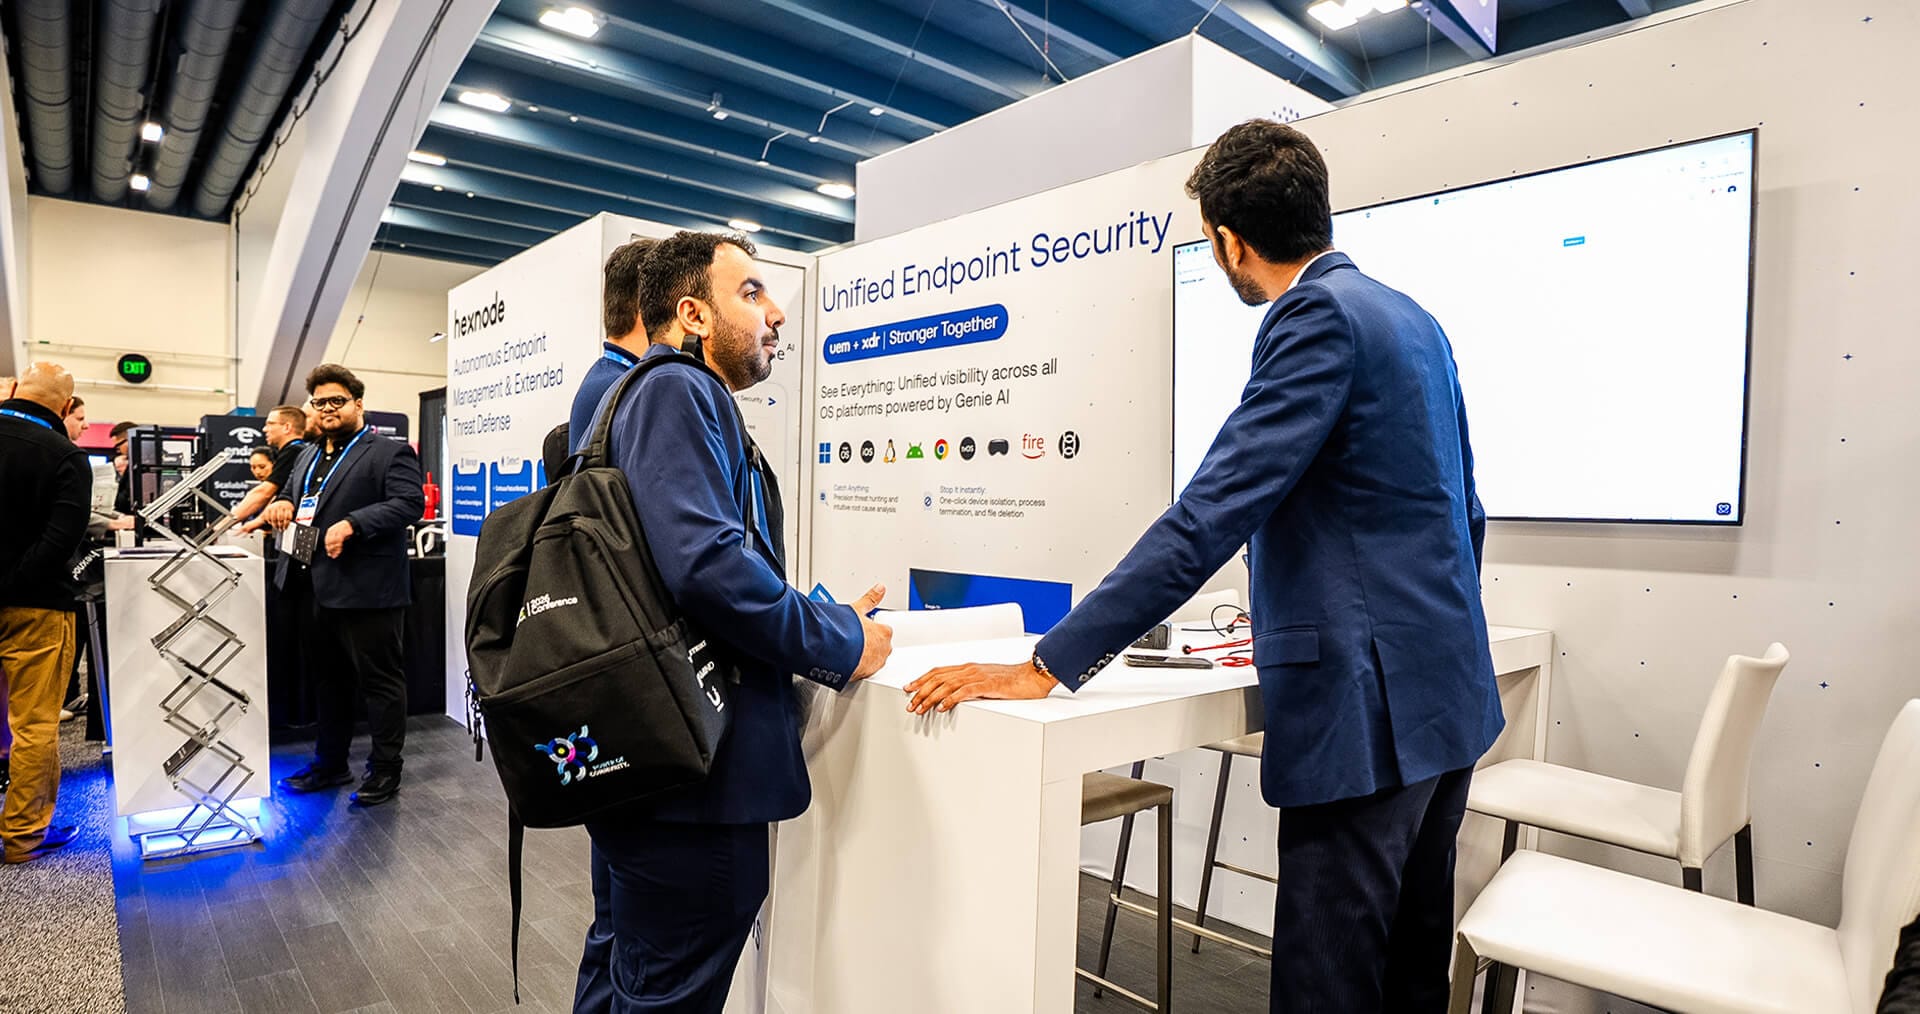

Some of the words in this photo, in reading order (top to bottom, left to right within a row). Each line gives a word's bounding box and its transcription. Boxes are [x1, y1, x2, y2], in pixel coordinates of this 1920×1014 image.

[822, 270, 895, 313] Unified
[903, 242, 1021, 294] Endpoint
[1031, 211, 1173, 268] Security
[454, 290, 505, 339] hexnode
[829, 341, 850, 354] uem
[862, 331, 880, 350] xdr
[889, 326, 938, 344] Stronger
[941, 314, 999, 338] Together
[454, 348, 501, 376] Autonomous
[504, 331, 547, 364] Endpoint
[123, 361, 146, 374] EXIT
[821, 385, 838, 399] See
[841, 379, 895, 398] Everything:
[898, 372, 937, 391] Unified
[940, 367, 989, 386] visibility
[991, 364, 1038, 380] across
[1042, 358, 1057, 375] all
[453, 381, 503, 408] Management
[505, 376, 513, 396] &
[515, 362, 564, 395] Extended
[820, 406, 834, 420] OS
[836, 400, 883, 420] platforms
[885, 396, 934, 417] powered
[937, 392, 951, 413] by
[955, 391, 993, 408] Genie
[996, 389, 1010, 405] AI
[453, 416, 476, 437] Threat
[477, 412, 511, 434] Defense
[224, 445, 255, 456] enda
[1022, 433, 1044, 449] fire
[869, 496, 887, 504] hunting
[939, 496, 967, 505] One-click
[969, 497, 988, 506] device
[990, 498, 1017, 507] isolation,
[1019, 499, 1046, 507] process
[940, 486, 953, 494] Stop
[975, 509, 987, 517] and
[988, 509, 997, 517] file
[998, 510, 1024, 518] deletion
[72, 550, 100, 580] hexnod
[531, 597, 578, 615] Conference
